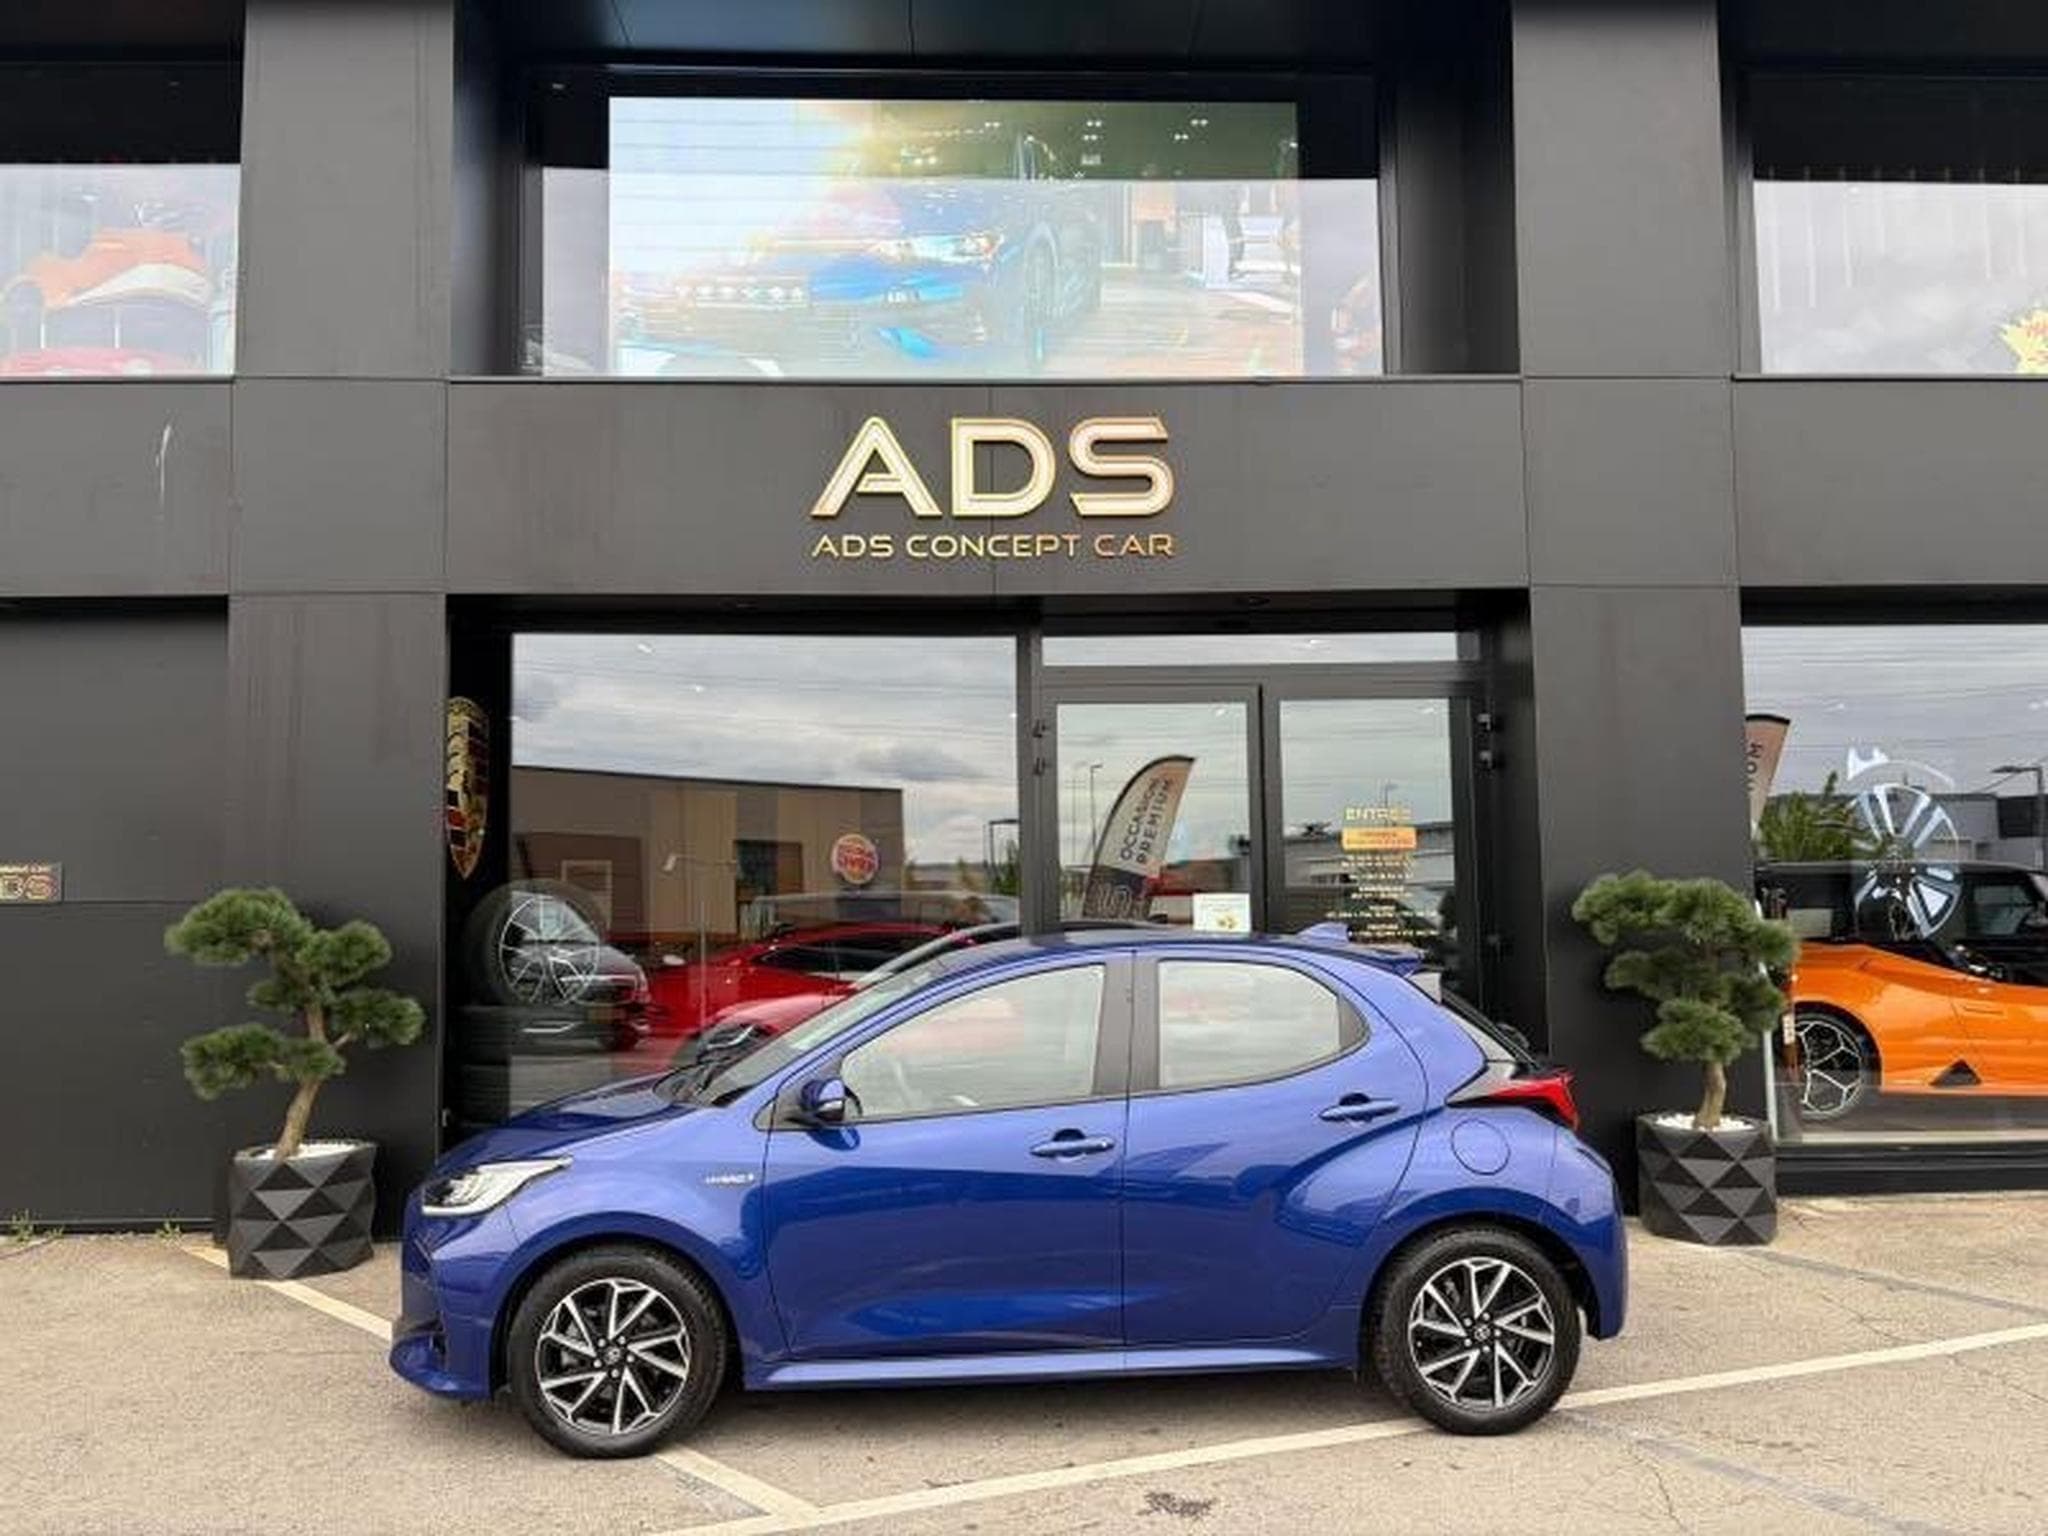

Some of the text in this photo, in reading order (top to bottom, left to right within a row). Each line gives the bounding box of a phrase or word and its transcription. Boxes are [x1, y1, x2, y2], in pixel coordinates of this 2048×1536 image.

[810, 416, 1174, 517] ADS
[811, 533, 1174, 558] ADS CONCEPT CAR
